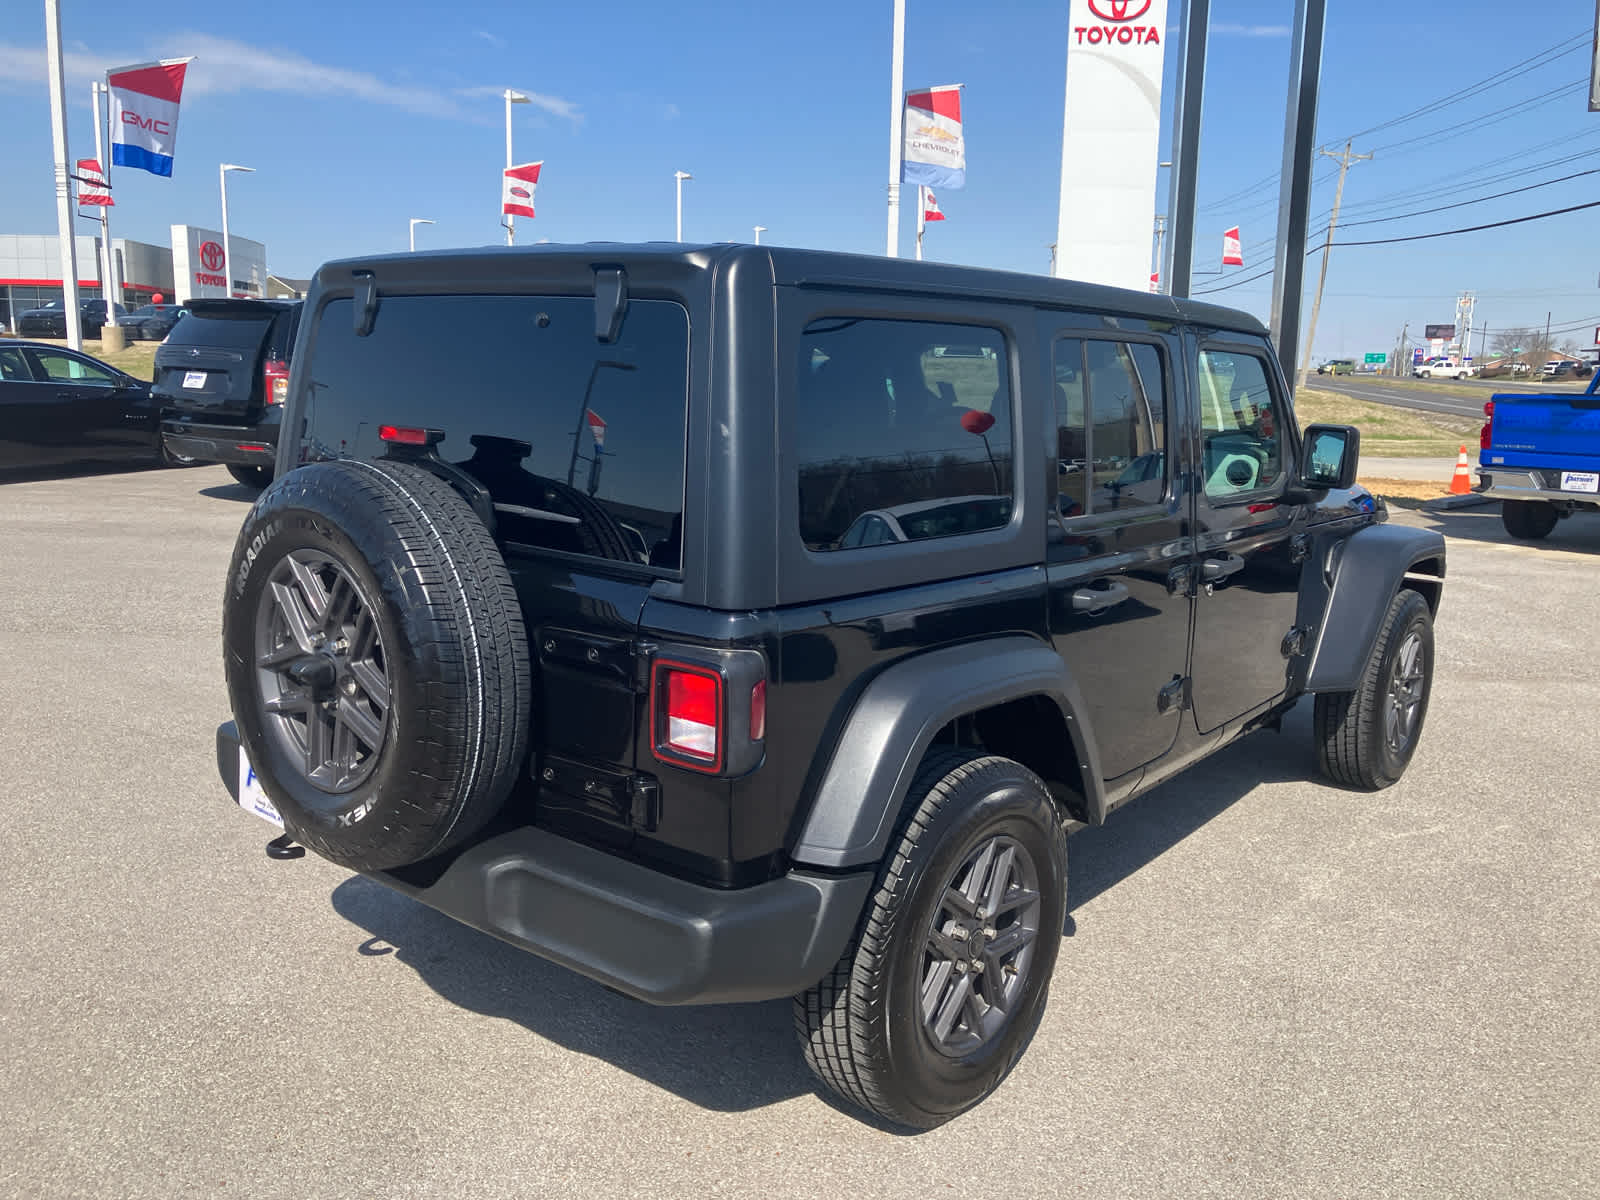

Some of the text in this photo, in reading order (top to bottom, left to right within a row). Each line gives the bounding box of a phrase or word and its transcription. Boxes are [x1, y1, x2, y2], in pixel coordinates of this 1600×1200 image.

[1074, 26, 1160, 45] TOYOTA
[121, 110, 169, 135] GMC
[912, 141, 960, 156] CHEVROLET
